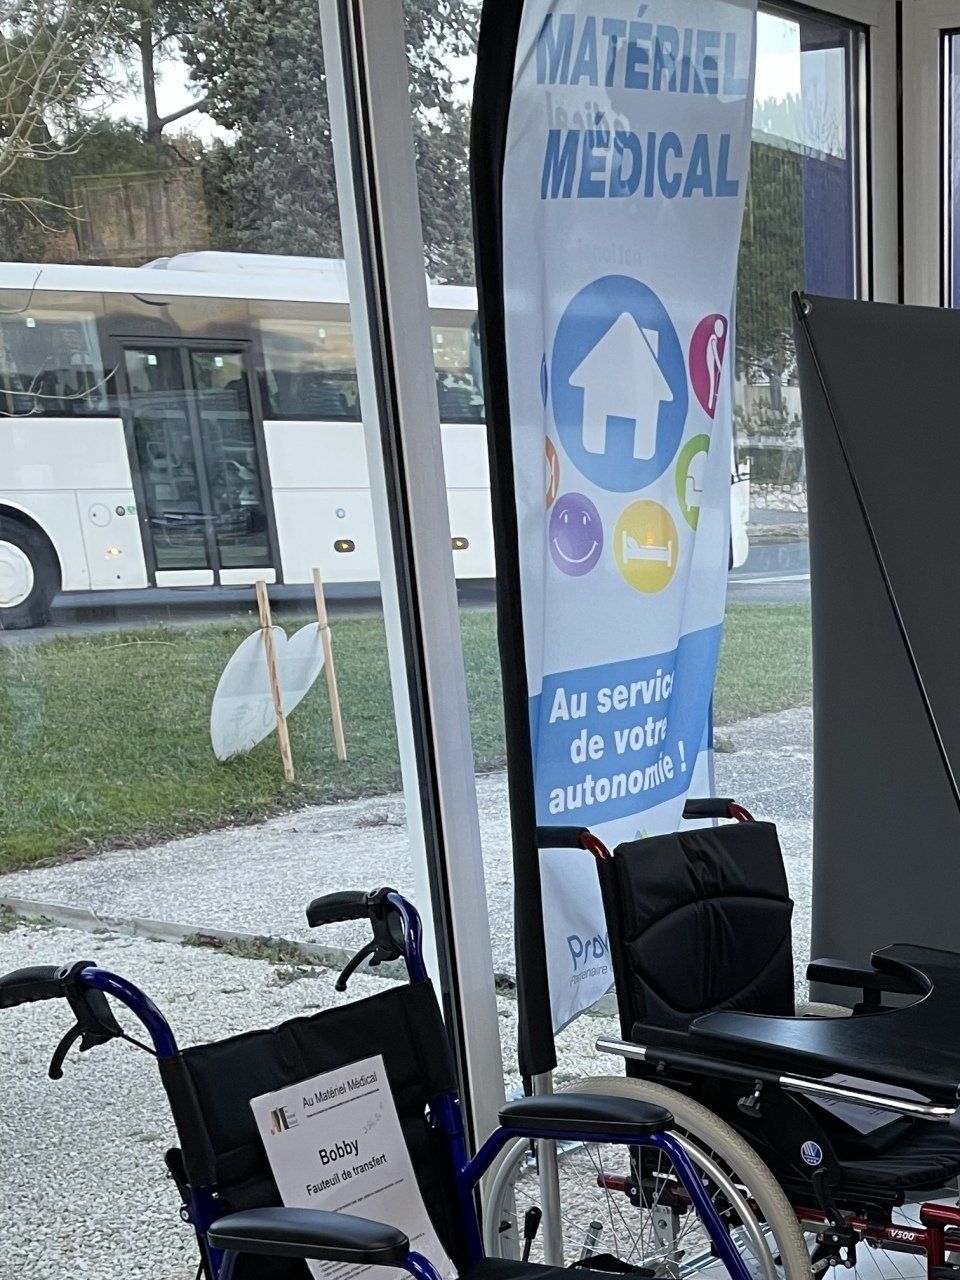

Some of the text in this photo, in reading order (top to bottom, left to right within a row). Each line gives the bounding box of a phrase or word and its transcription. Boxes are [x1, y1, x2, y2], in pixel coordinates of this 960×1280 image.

[536, 4, 748, 95] MATÉRIEL
[540, 111, 740, 200] MÉDICAL
[549, 687, 588, 723] Au
[570, 716, 668, 764] de votre
[549, 740, 687, 815] autonomie !
[567, 931, 610, 971] Prov
[302, 1071, 378, 1109] Au Matériel Médical
[318, 1139, 360, 1166] Bobby
[306, 1173, 341, 1196] Fauteuil
[341, 1169, 353, 1181] de
[352, 1153, 388, 1176] transfert
[890, 1229, 916, 1241] V500
